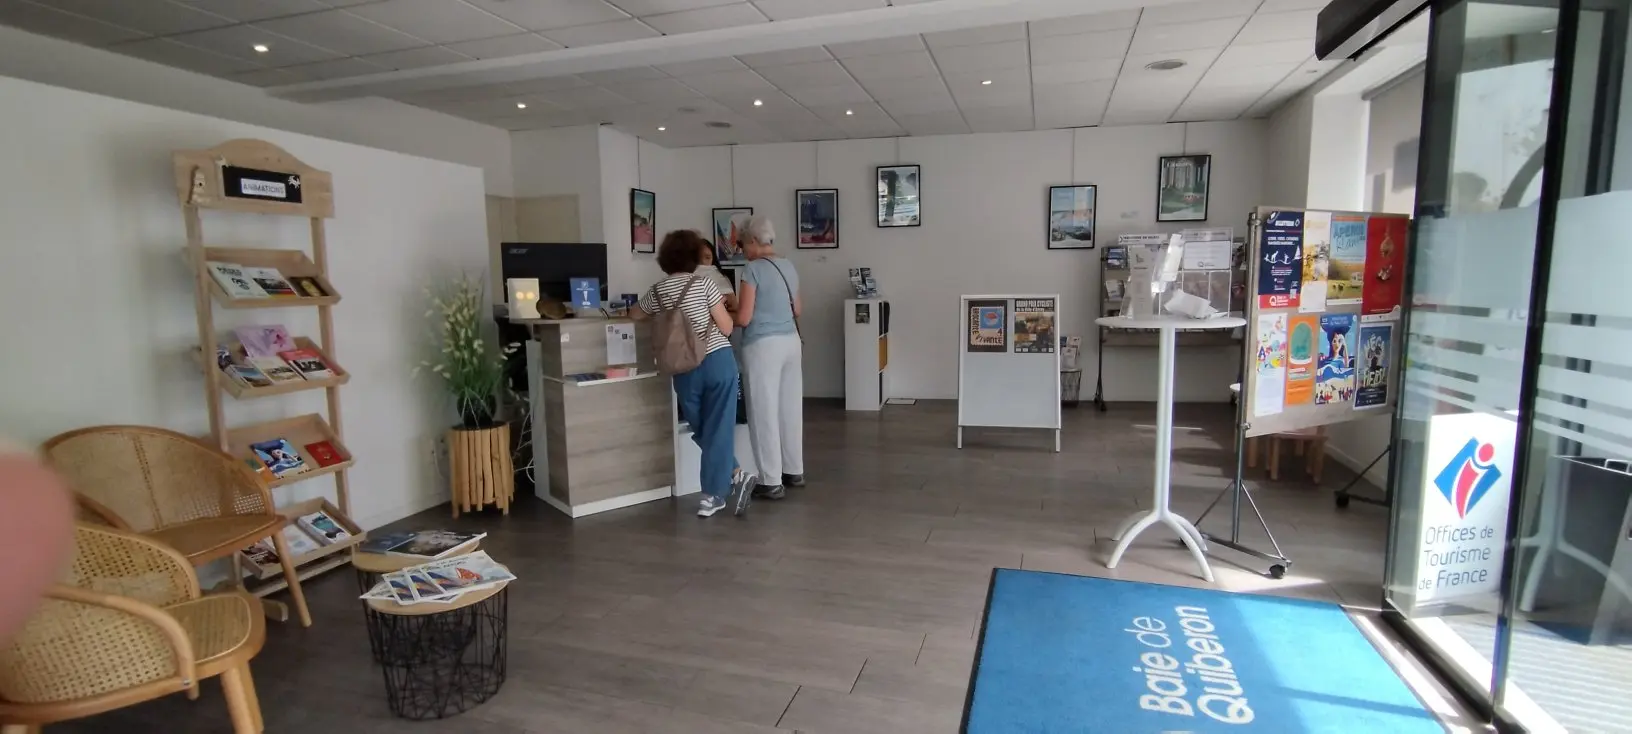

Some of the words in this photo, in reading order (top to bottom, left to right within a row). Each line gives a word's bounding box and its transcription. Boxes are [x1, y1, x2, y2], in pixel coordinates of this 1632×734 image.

[1425, 525, 1476, 546] Offices
[1480, 525, 1494, 539] de
[1423, 547, 1491, 567] Tourisme
[1418, 577, 1433, 591] de
[1437, 568, 1488, 589] France
[1124, 616, 1172, 648] de
[1175, 605, 1255, 725] Quiberon
[1132, 652, 1195, 717] Baie
